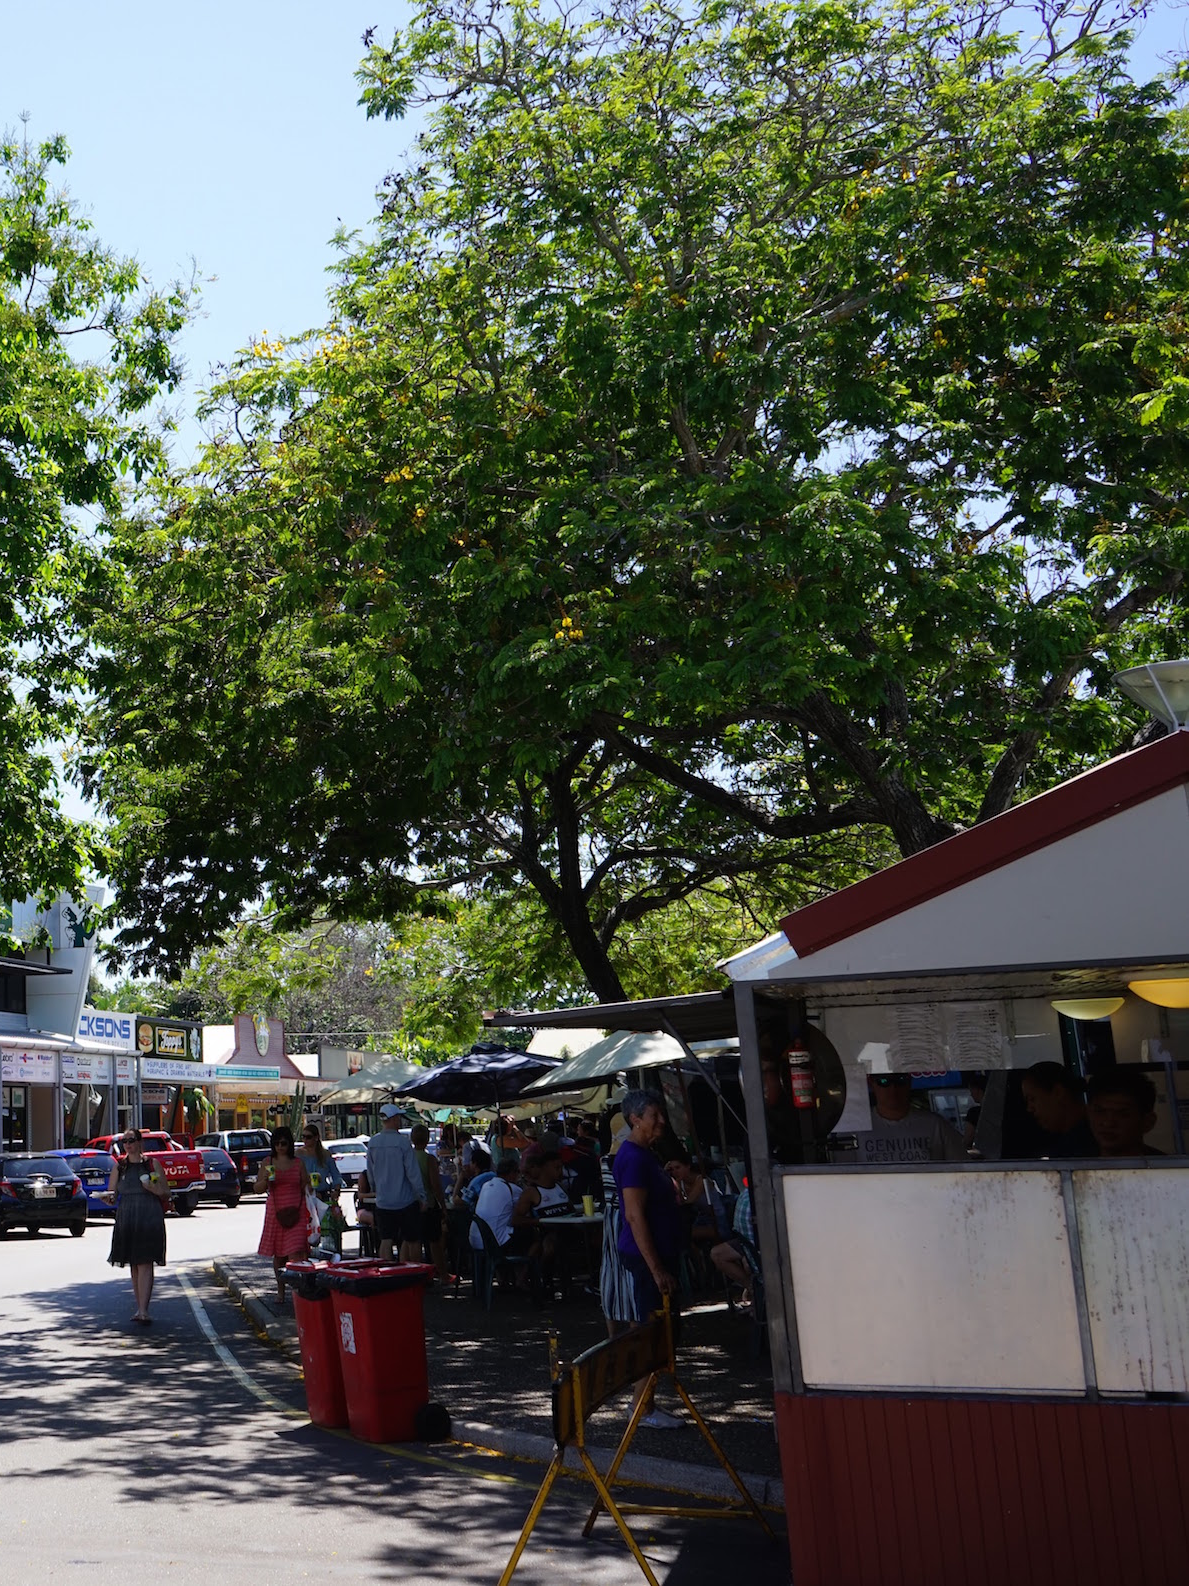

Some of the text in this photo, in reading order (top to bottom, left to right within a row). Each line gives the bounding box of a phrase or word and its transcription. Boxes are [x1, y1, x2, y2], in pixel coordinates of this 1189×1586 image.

[79, 1015, 130, 1039] CKSONS
[865, 1136, 930, 1152] GENUINE
[866, 1150, 928, 1162] WEST COAS
[163, 1165, 190, 1176] YOTA
